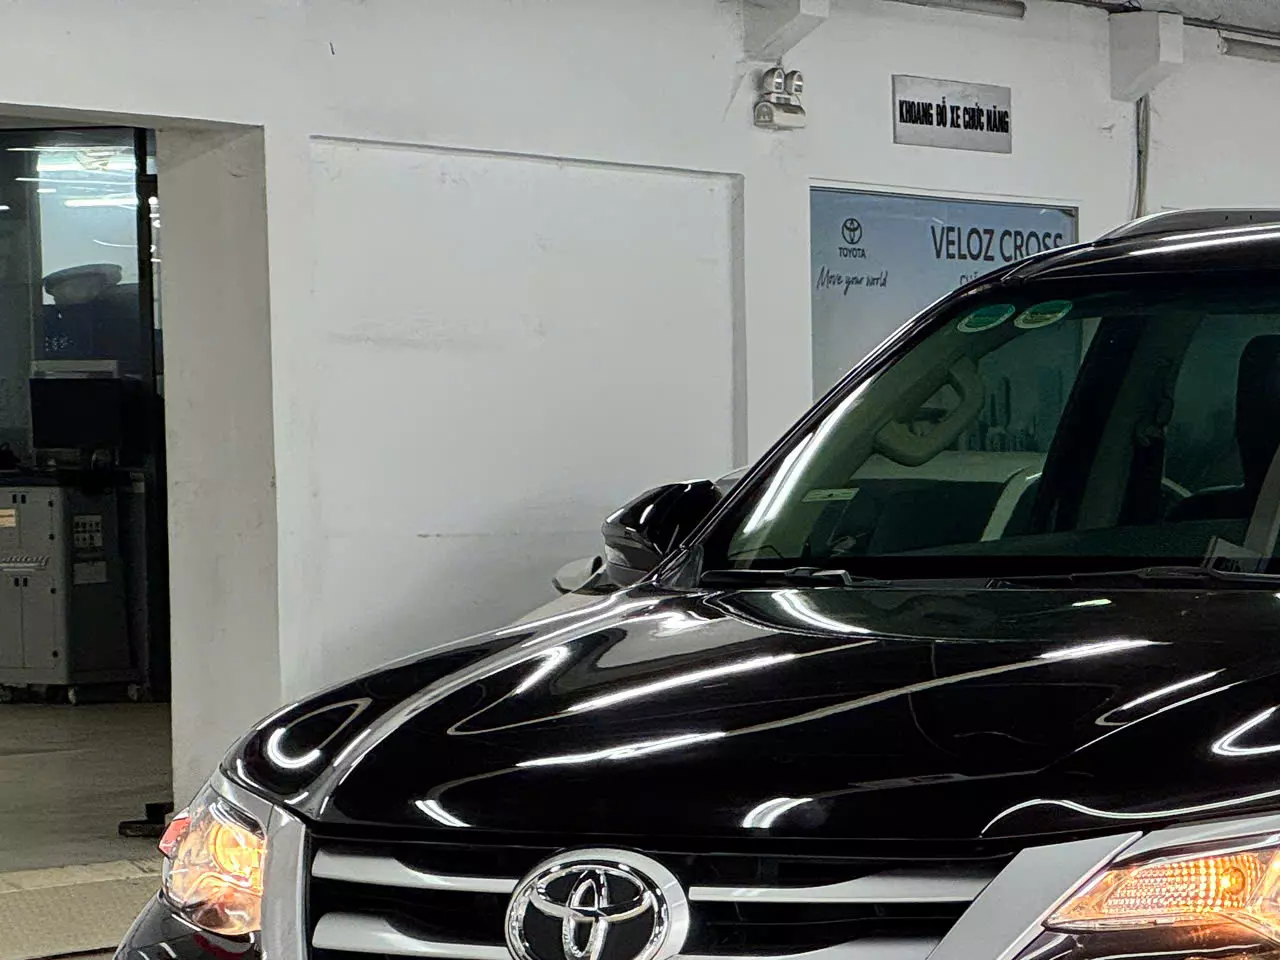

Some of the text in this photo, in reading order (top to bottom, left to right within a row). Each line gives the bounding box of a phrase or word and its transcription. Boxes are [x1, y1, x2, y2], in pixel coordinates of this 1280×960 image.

[898, 99, 933, 125] KHOANG
[950, 105, 961, 128] XE
[838, 247, 866, 259] TOYOTA
[931, 225, 995, 261] VELOZ
[816, 266, 889, 296] Move your world
